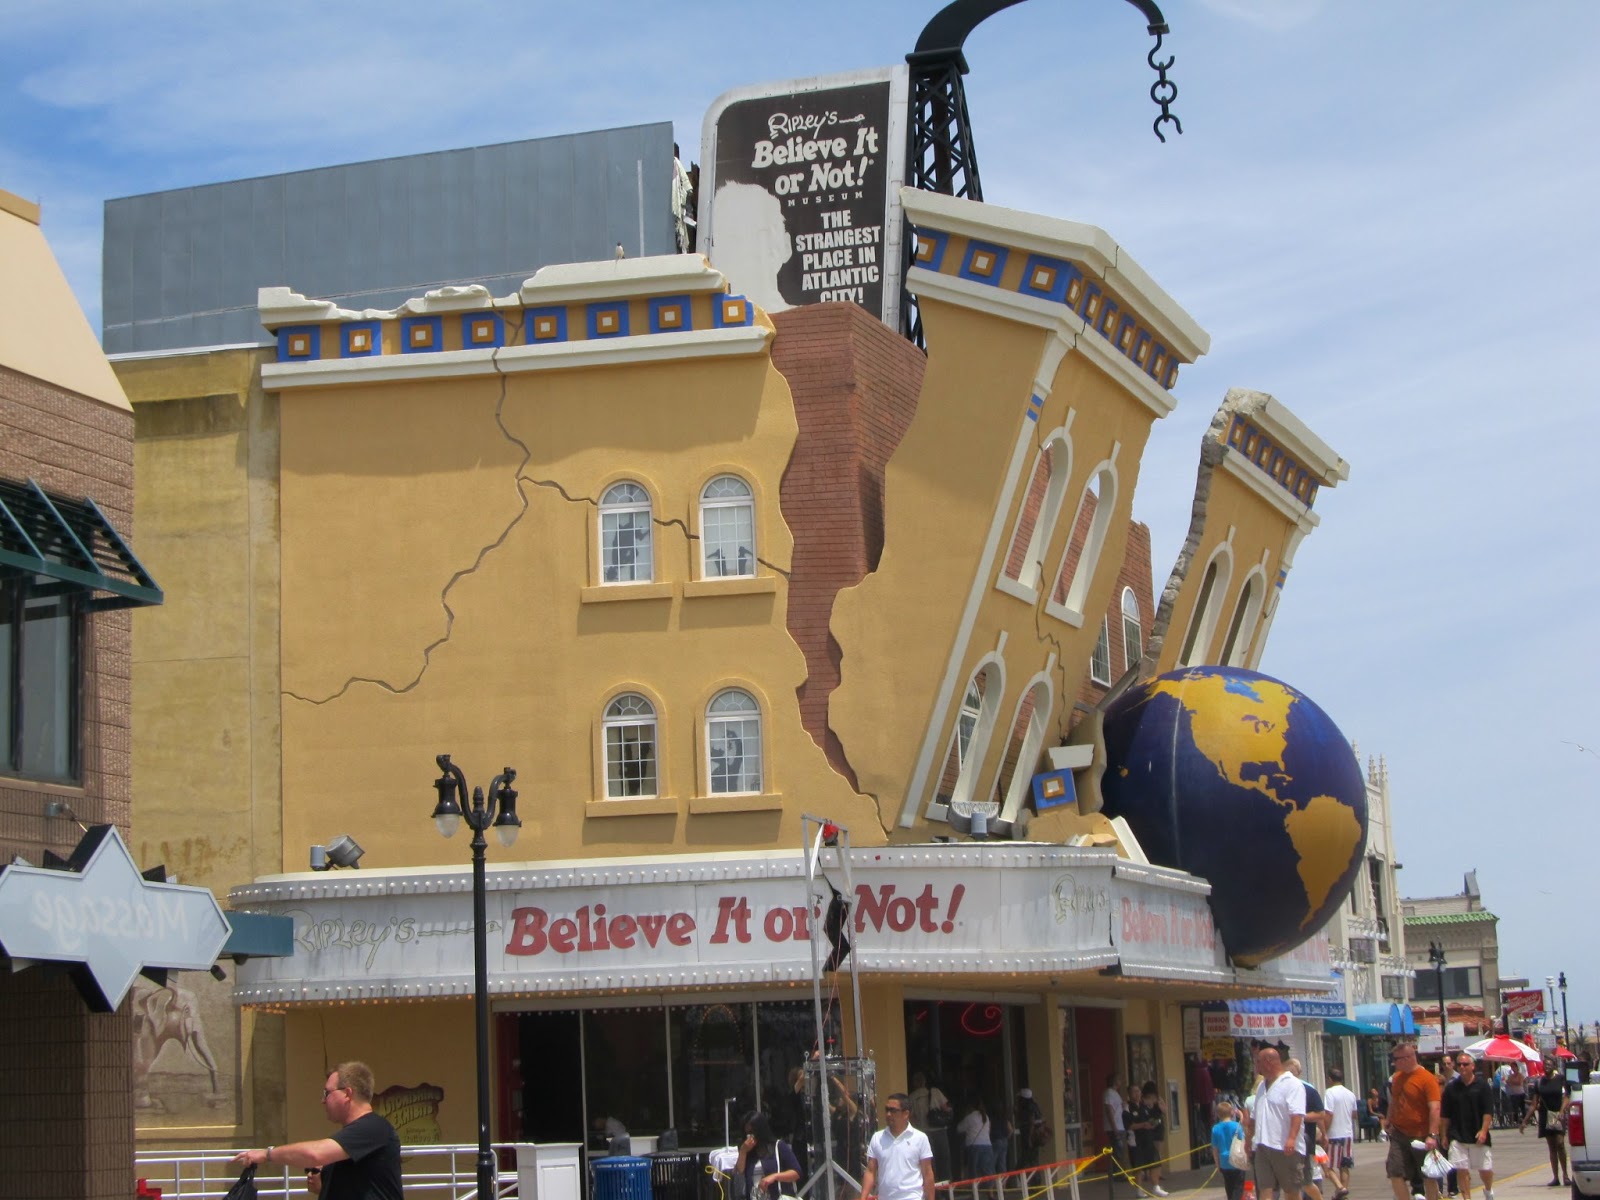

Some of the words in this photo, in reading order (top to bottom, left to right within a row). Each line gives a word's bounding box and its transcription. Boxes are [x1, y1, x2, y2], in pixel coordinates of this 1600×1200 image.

[751, 136, 847, 168] Believe
[853, 127, 878, 155] It
[775, 172, 804, 195] or
[808, 156, 868, 191] Not!
[788, 191, 863, 207] MUSEUM
[821, 210, 851, 229] THE
[796, 226, 881, 252] STRANGEST
[803, 248, 853, 271] PLACE
[858, 246, 876, 264] IN
[802, 265, 880, 291] ATLANTIC
[820, 287, 864, 303] CITY!
[505, 903, 696, 956] Believe
[710, 896, 752, 944] It
[763, 905, 820, 942] or
[854, 883, 965, 934] Not!
